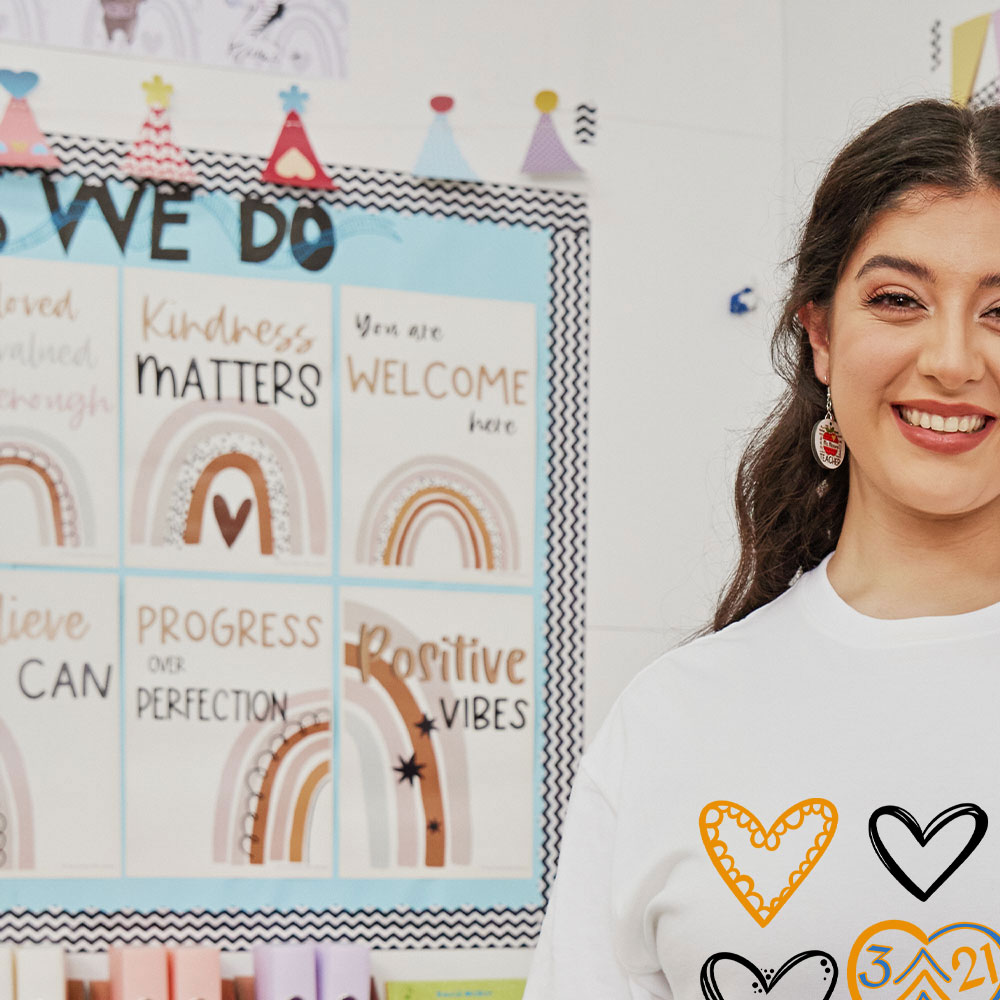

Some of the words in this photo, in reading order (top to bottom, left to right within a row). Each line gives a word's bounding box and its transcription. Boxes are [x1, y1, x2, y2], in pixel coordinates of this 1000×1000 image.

[40, 175, 192, 262] WE
[240, 195, 335, 272] DO
[142, 294, 316, 354] Kindness
[355, 312, 399, 339] You
[408, 323, 444, 342] are
[347, 355, 530, 406] WELCOME
[468, 411, 519, 436] here
[138, 605, 324, 649] PROGRESS
[148, 655, 186, 675] OVER
[359, 623, 528, 686] Positive
[18, 658, 113, 700] CAN
[137, 677, 288, 722] PERFECTION
[440, 696, 530, 731] VIBES
[857, 943, 893, 989] 3
[950, 942, 999, 993] 21
